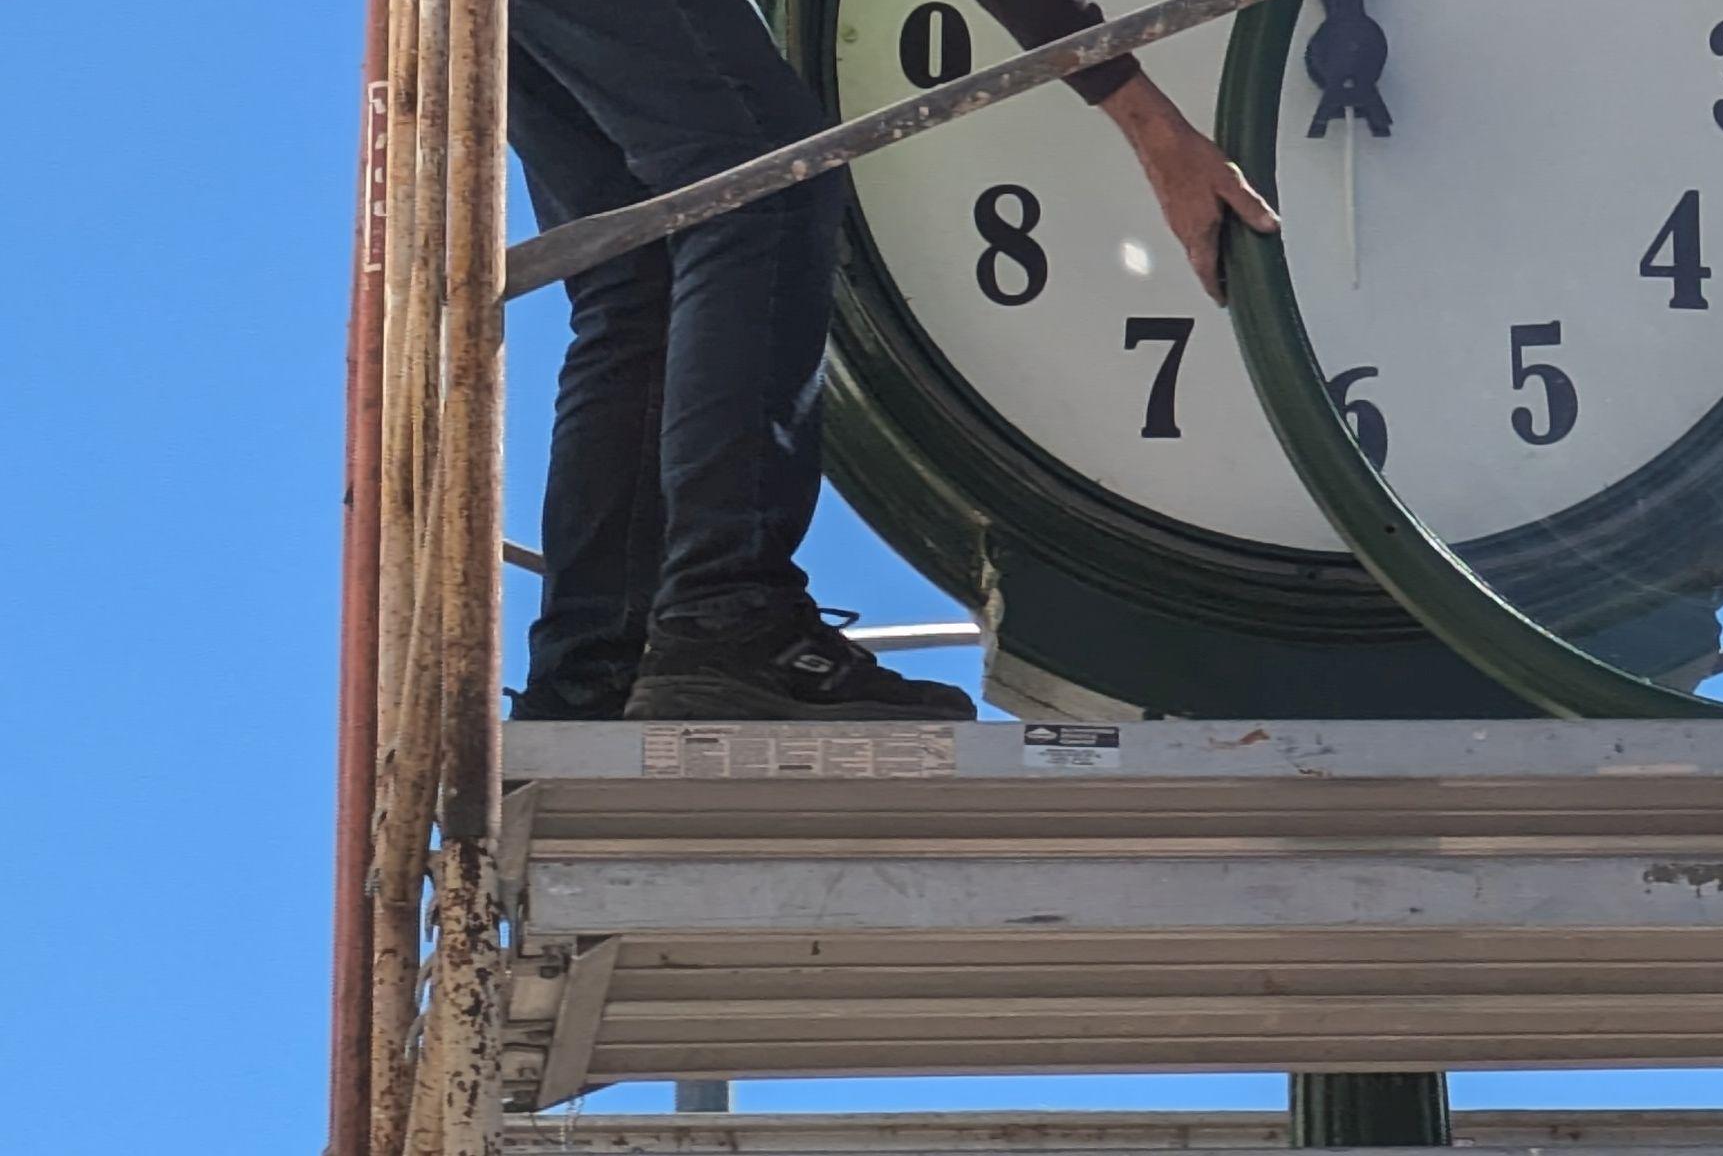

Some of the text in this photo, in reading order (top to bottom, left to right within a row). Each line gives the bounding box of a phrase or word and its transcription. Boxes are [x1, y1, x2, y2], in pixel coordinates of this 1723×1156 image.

[973, 183, 1048, 307] 8
[1639, 189, 1712, 310] 4
[1124, 316, 1195, 439] 7
[1325, 366, 1389, 474] 6
[1510, 320, 1579, 446] 5
